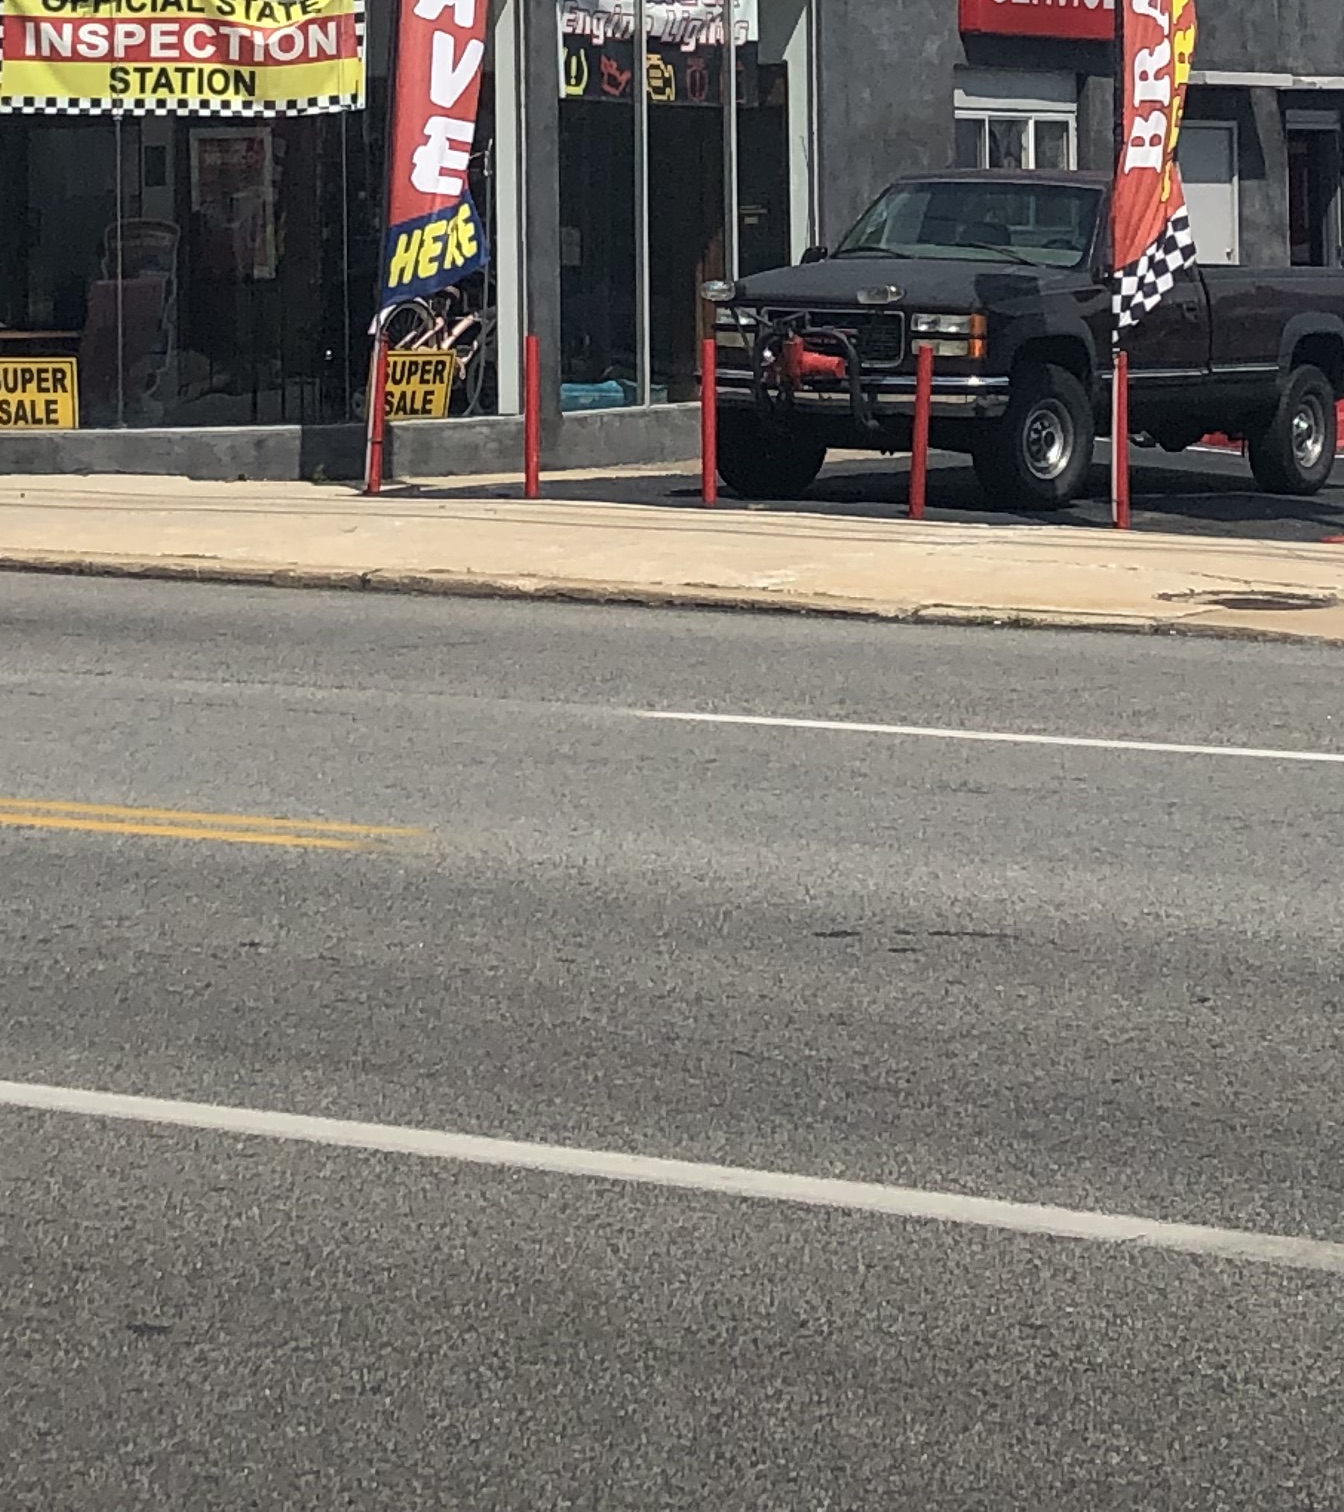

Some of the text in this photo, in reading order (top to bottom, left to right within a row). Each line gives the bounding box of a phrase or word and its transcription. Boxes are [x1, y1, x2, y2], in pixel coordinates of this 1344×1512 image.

[25, 21, 338, 63] INSPECTION
[108, 66, 257, 97] STATION
[387, 202, 478, 289] HERE
[383, 390, 435, 417] SALE
